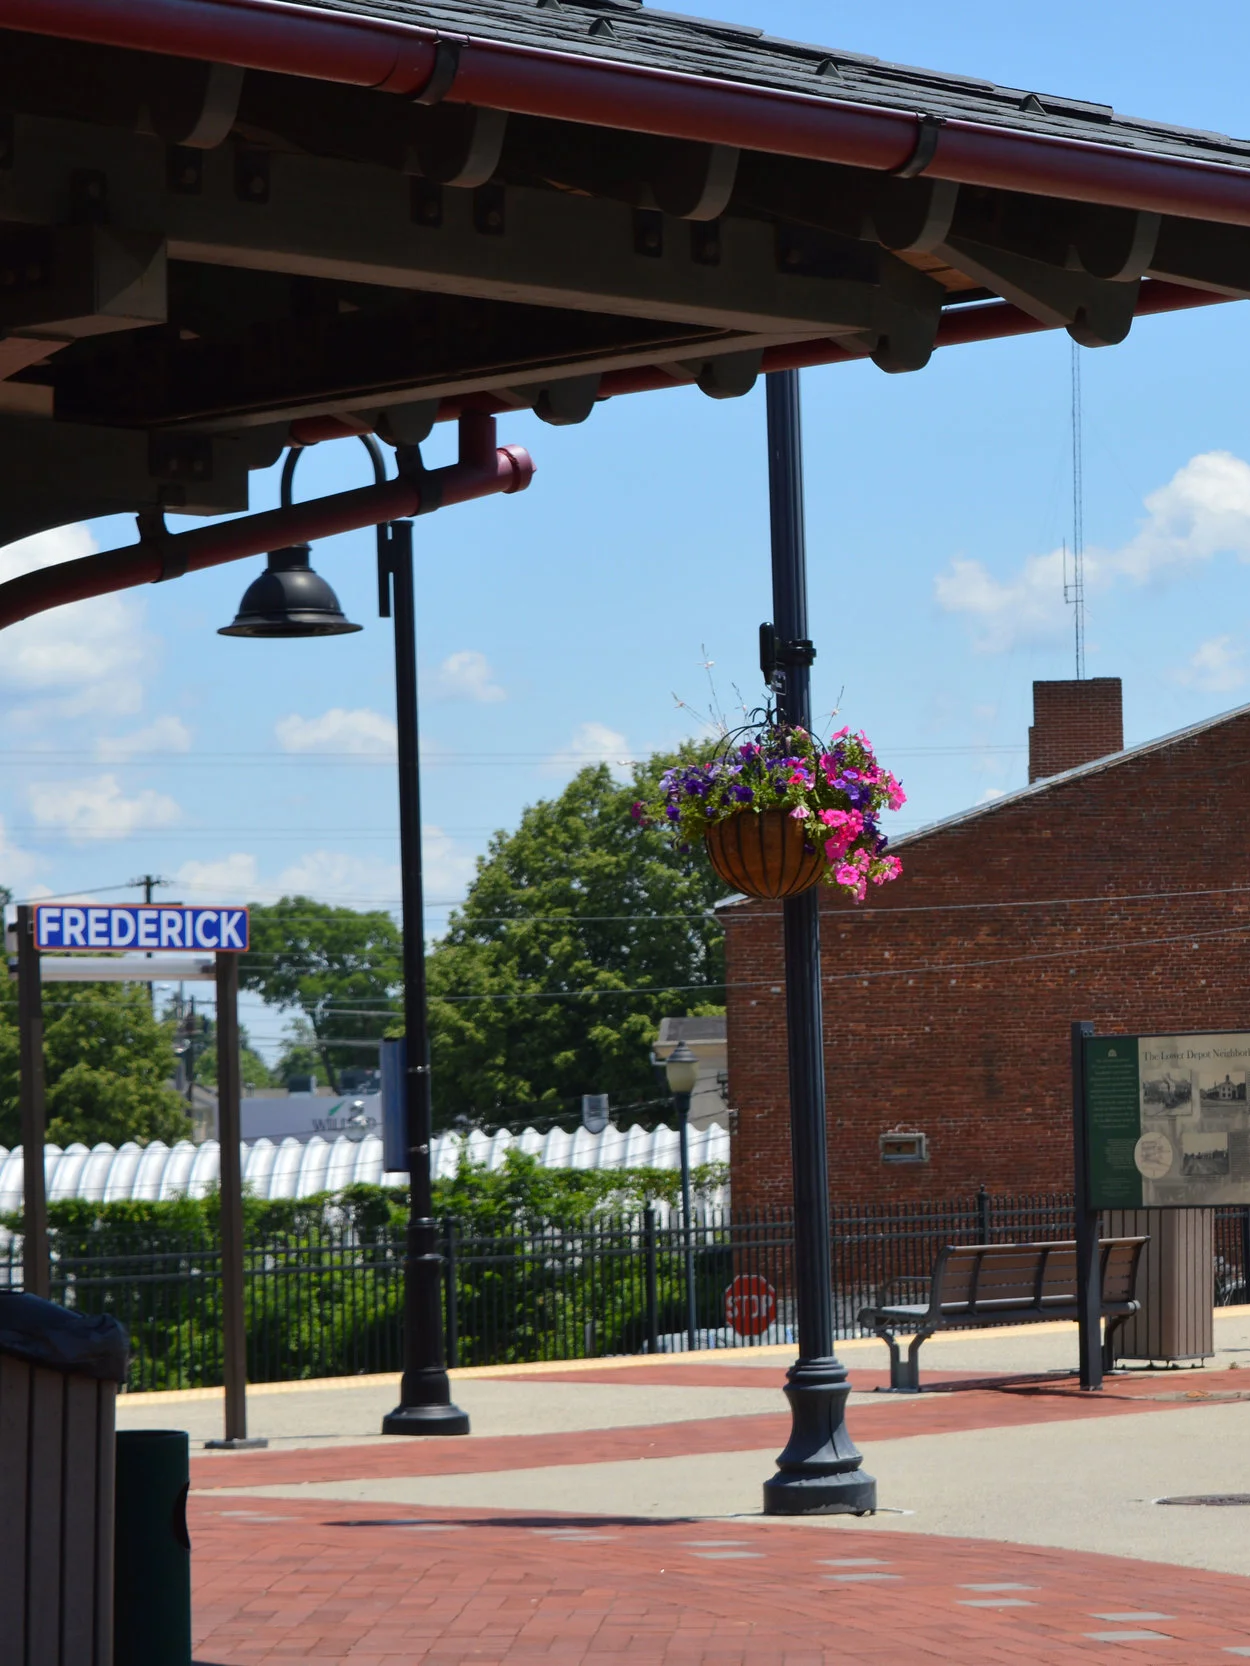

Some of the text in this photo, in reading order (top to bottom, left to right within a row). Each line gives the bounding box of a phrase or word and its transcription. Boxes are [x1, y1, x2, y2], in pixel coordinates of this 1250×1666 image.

[39, 907, 244, 948] FREDERICK
[1143, 1051, 1158, 1061] The
[1161, 1050, 1184, 1060] Lower
[1187, 1049, 1210, 1061] Depot
[727, 1294, 773, 1318] STOP
